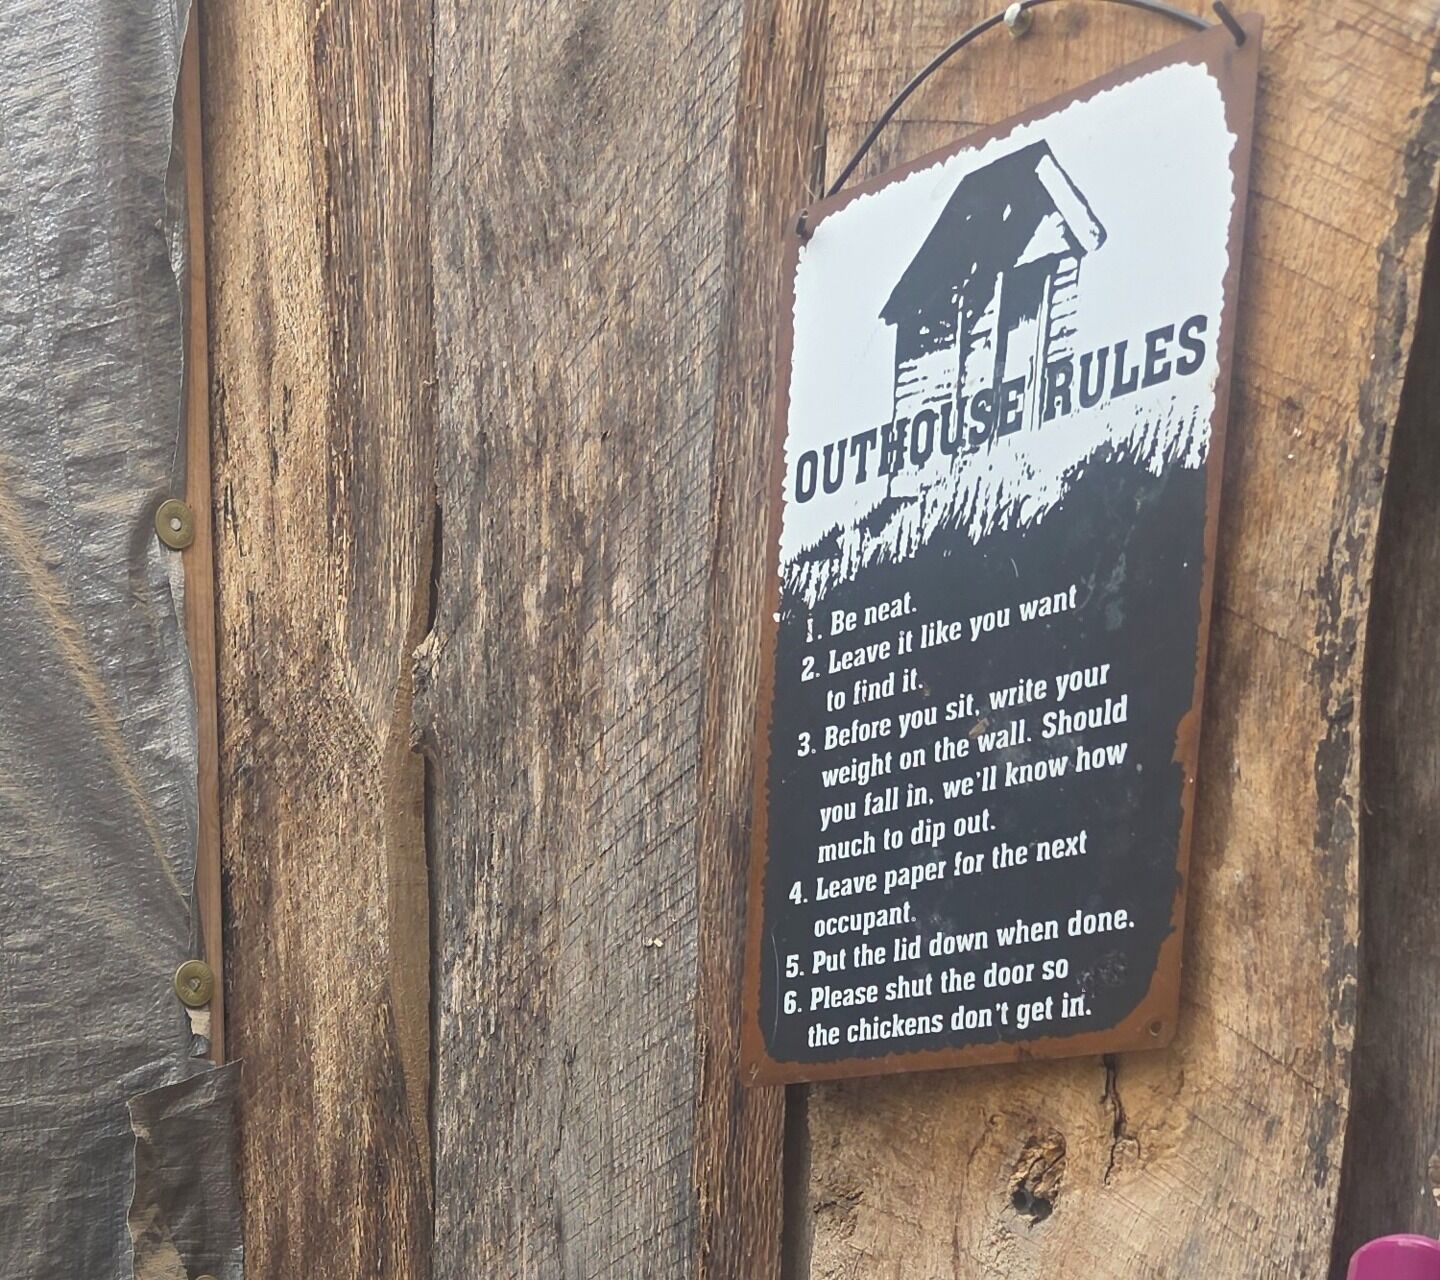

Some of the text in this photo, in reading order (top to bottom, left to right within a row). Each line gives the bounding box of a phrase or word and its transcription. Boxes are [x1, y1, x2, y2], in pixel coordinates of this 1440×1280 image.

[795, 315, 1209, 504] OUTHOUSE RULES
[801, 584, 1077, 682] 2. Leave it like you want
[805, 592, 917, 643] 1. Be neat.
[797, 663, 1110, 757] 3. Before you sit, write your
[827, 668, 923, 712] to find it.
[821, 694, 1128, 788] weight on the wall. Should
[819, 742, 1128, 832] you fall in, we'll know how
[788, 829, 1087, 905] 4. Leave paper for the next
[817, 808, 996, 864] much to dip out.
[785, 909, 1135, 978] 5. Put the lid down when done.
[814, 901, 917, 938] occupant.
[783, 958, 1069, 1015] 6. Please shut the door so
[808, 991, 1092, 1048] the chickens don't get in.
